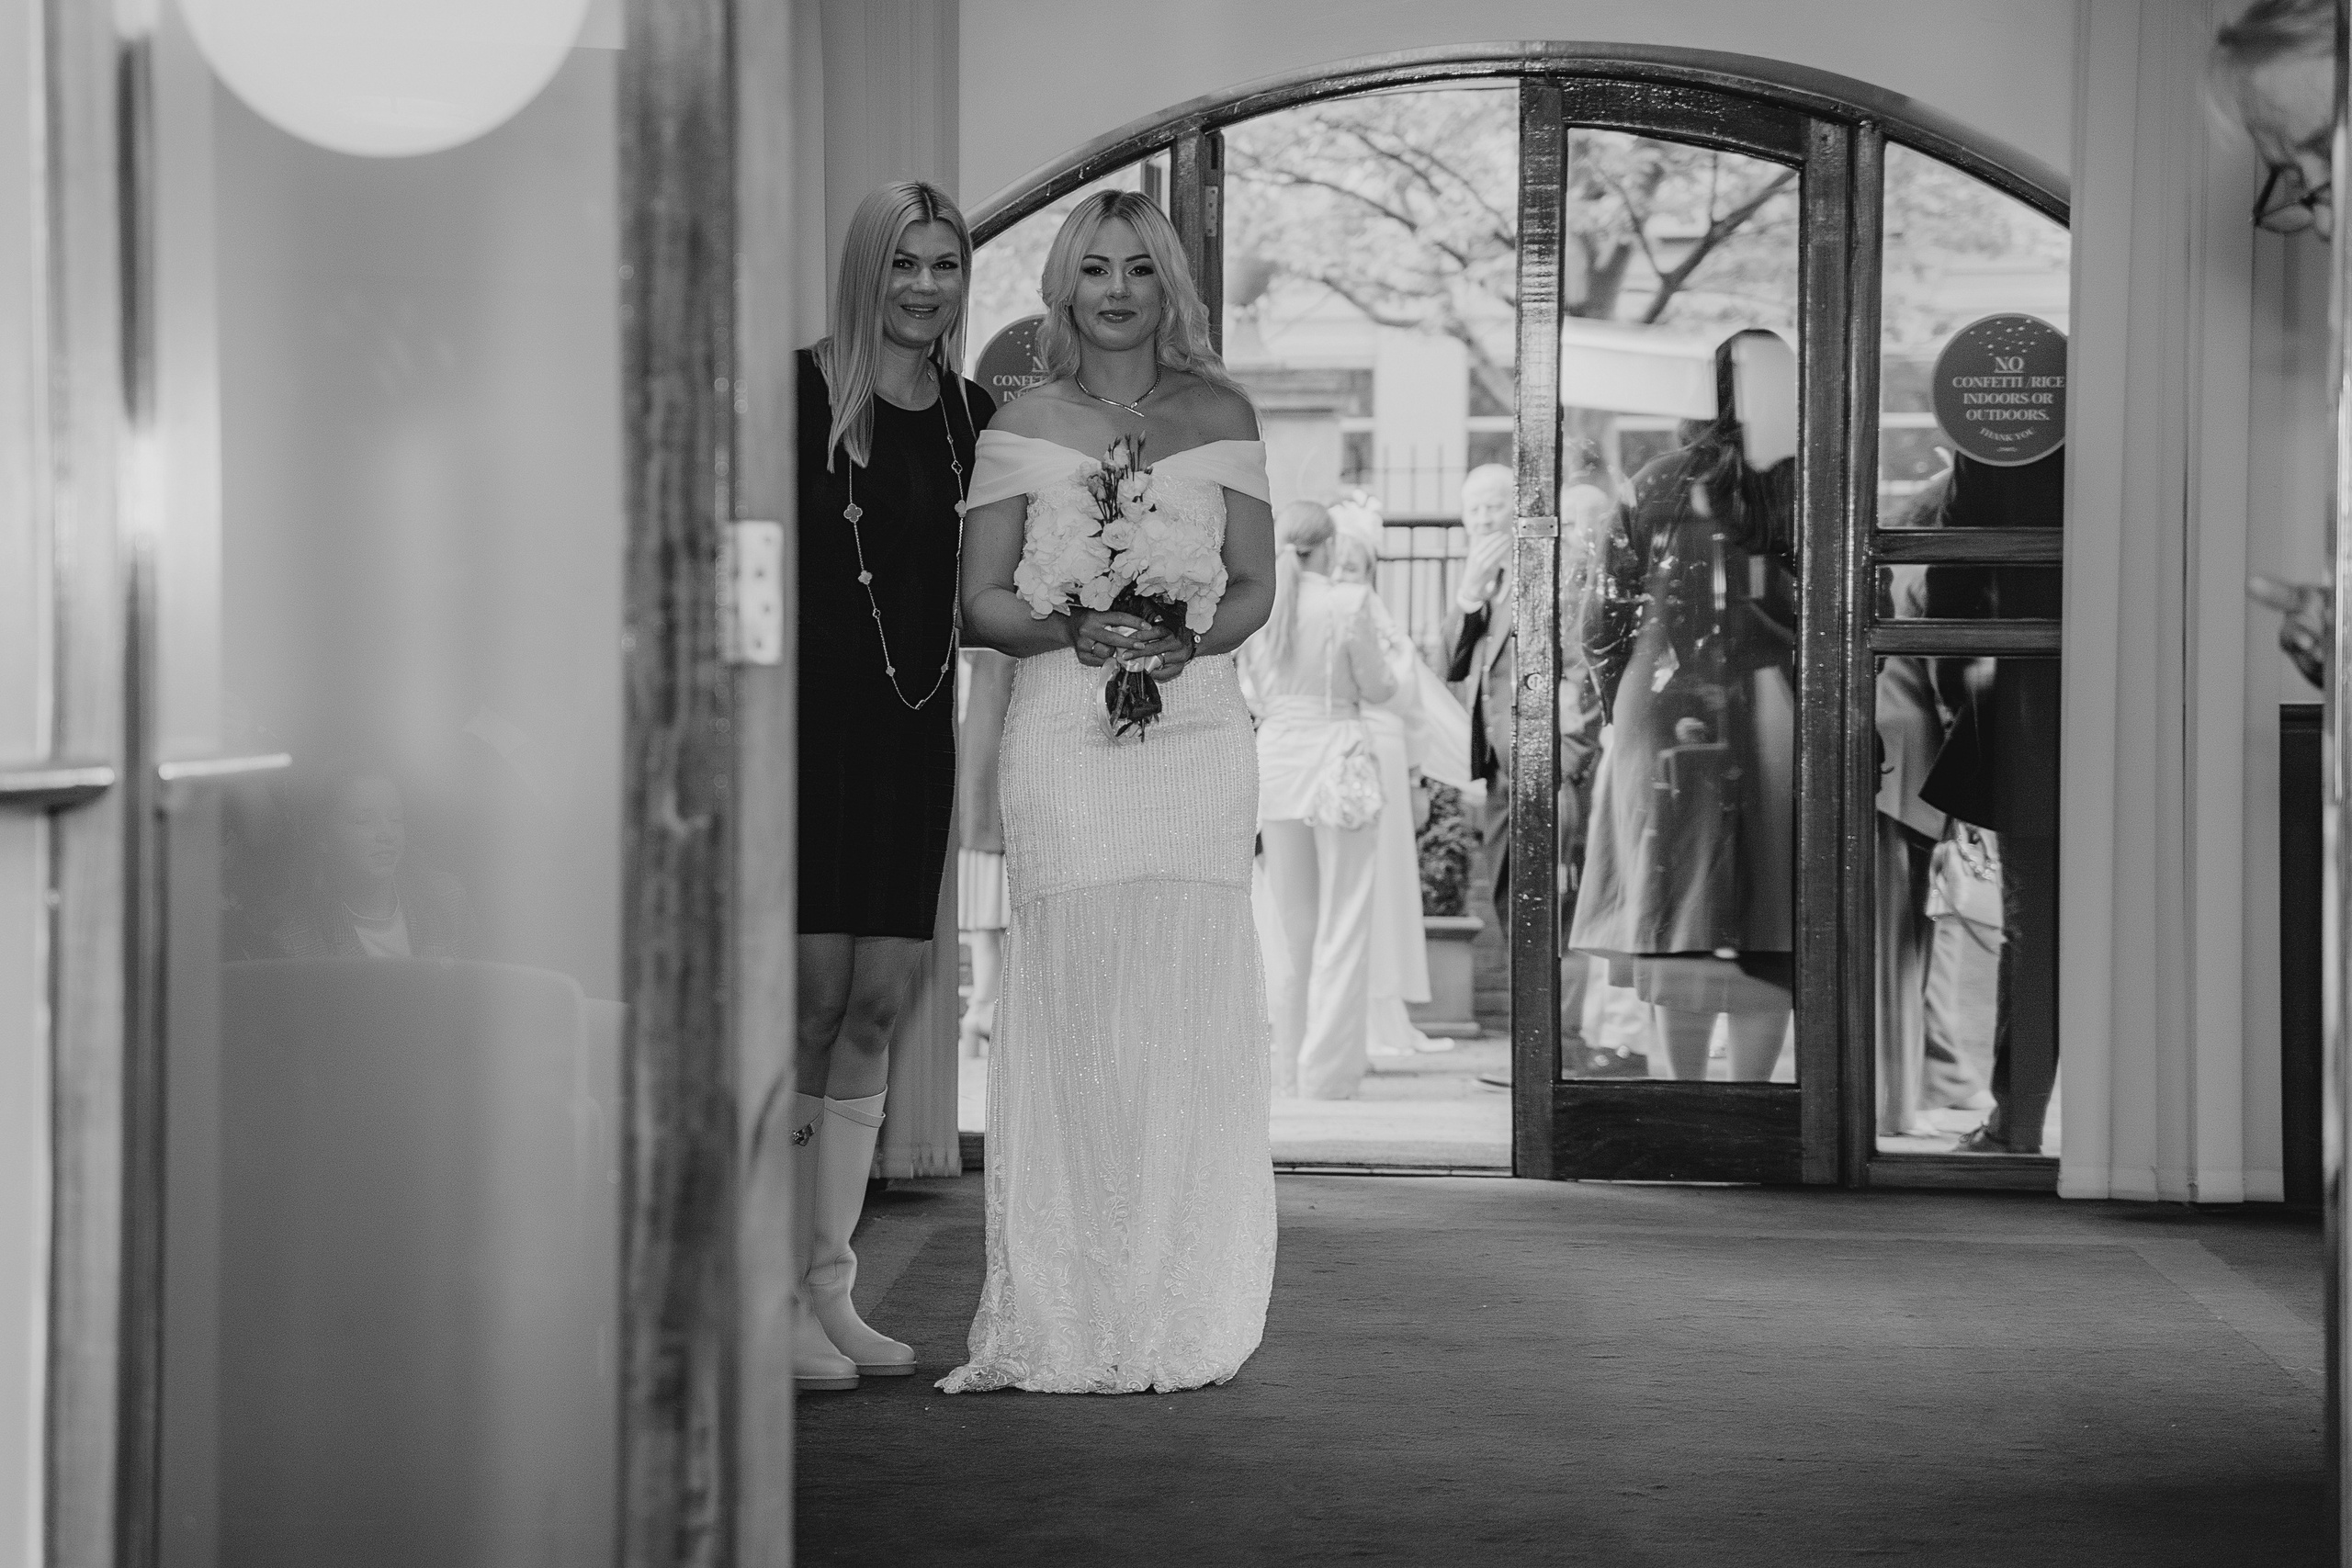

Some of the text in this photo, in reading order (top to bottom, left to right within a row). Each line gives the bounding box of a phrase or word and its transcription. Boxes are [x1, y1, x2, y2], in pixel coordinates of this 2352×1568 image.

[1995, 355, 2025, 372] NO
[1952, 376, 2023, 388] CONFETTI
[1963, 392, 2053, 404] INDOORS OR
[1965, 409, 2050, 421] OUTDOORS.
[1980, 426, 2034, 441] THANK YOU
